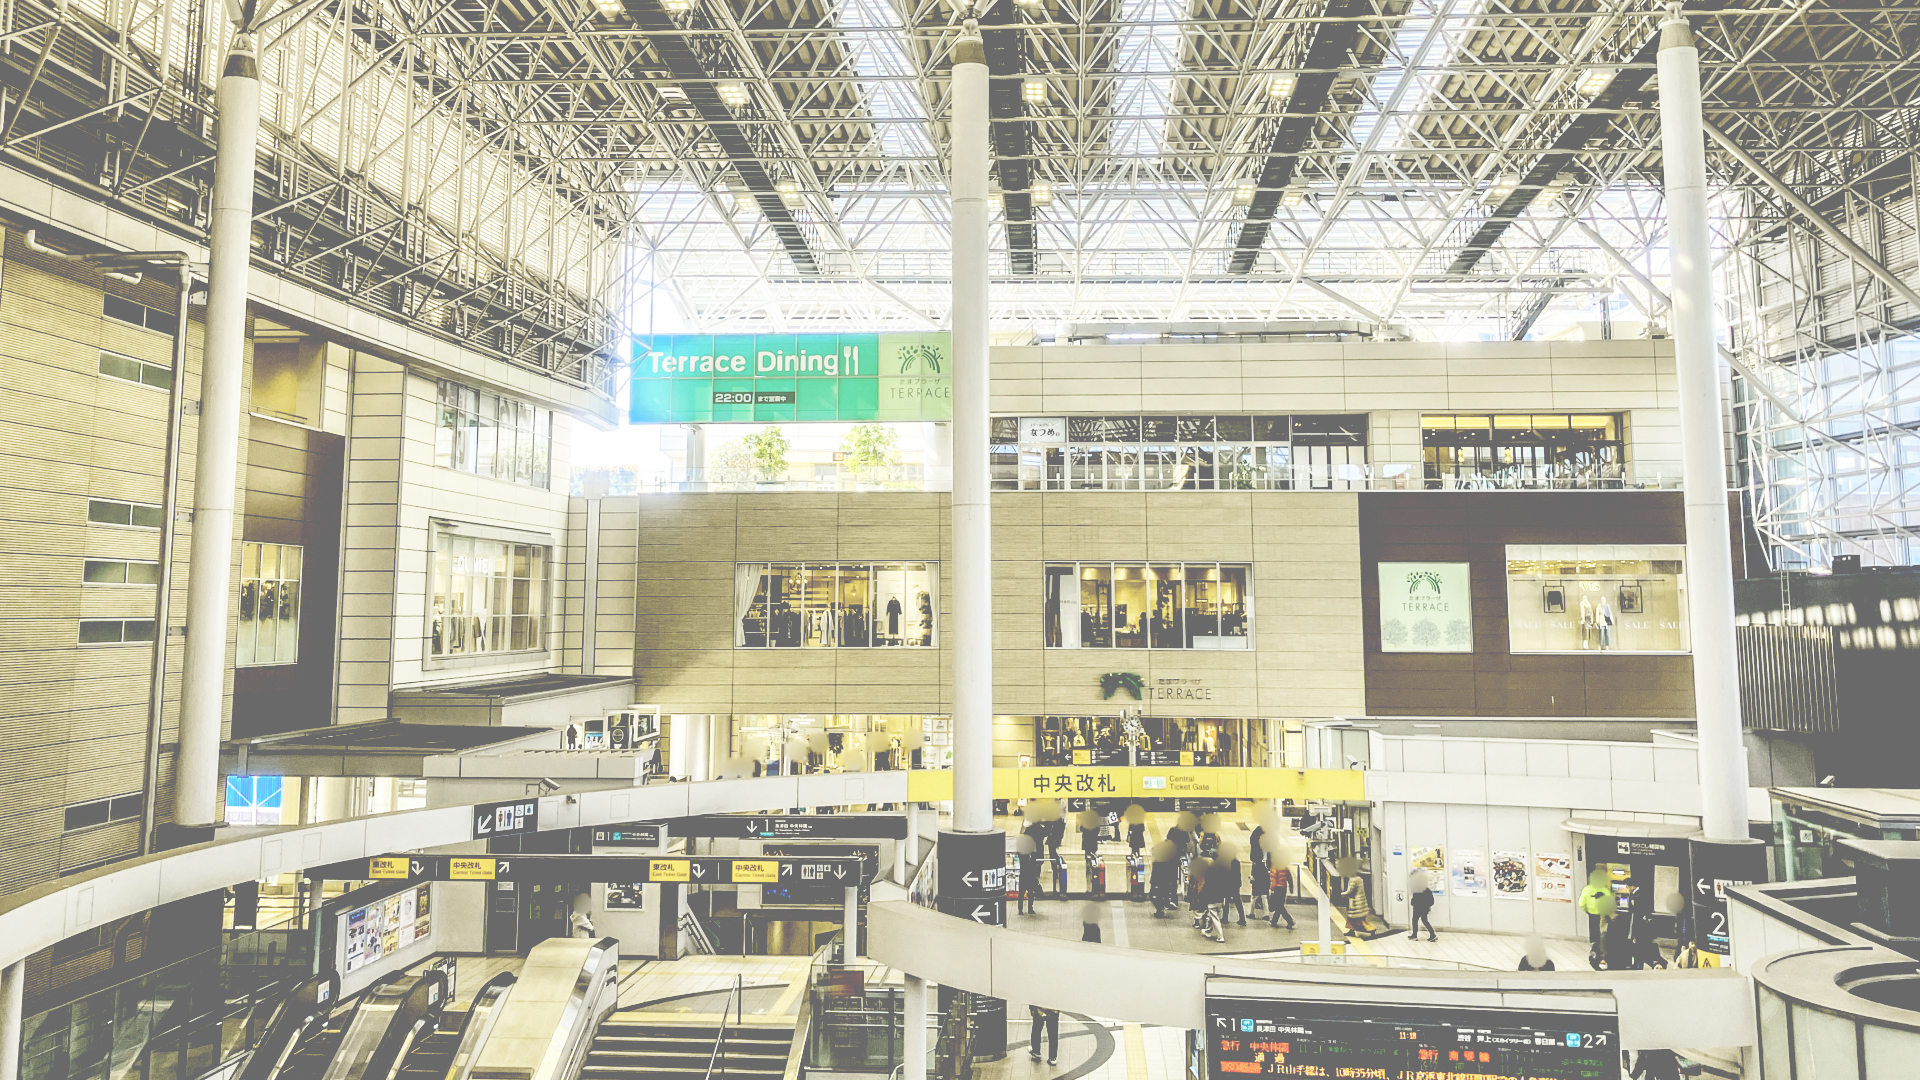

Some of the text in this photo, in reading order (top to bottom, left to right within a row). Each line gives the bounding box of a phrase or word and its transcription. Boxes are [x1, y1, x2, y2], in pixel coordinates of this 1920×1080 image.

[649, 350, 838, 376] Terrace Dining
[715, 393, 752, 403] 22:00
[890, 387, 950, 399] TERRACE
[1030, 428, 1055, 437] なつめ
[1402, 603, 1449, 612] TERRACE
[1551, 621, 1575, 629] SALE
[1625, 621, 1649, 630] SALE
[1149, 687, 1212, 700] TERRACE
[1033, 774, 1116, 793] 中央改札
[1192, 783, 1210, 791] Gate
[372, 861, 394, 869] 東改札
[453, 861, 481, 870] 中央改札
[653, 863, 675, 871] 東改札
[735, 864, 764, 872] 中央改札
[993, 901, 999, 923] 1
[1711, 912, 1726, 936] 2
[1230, 1018, 1236, 1031] 1
[1220, 1039, 1240, 1051] 急行
[1583, 1034, 1593, 1048] 2
